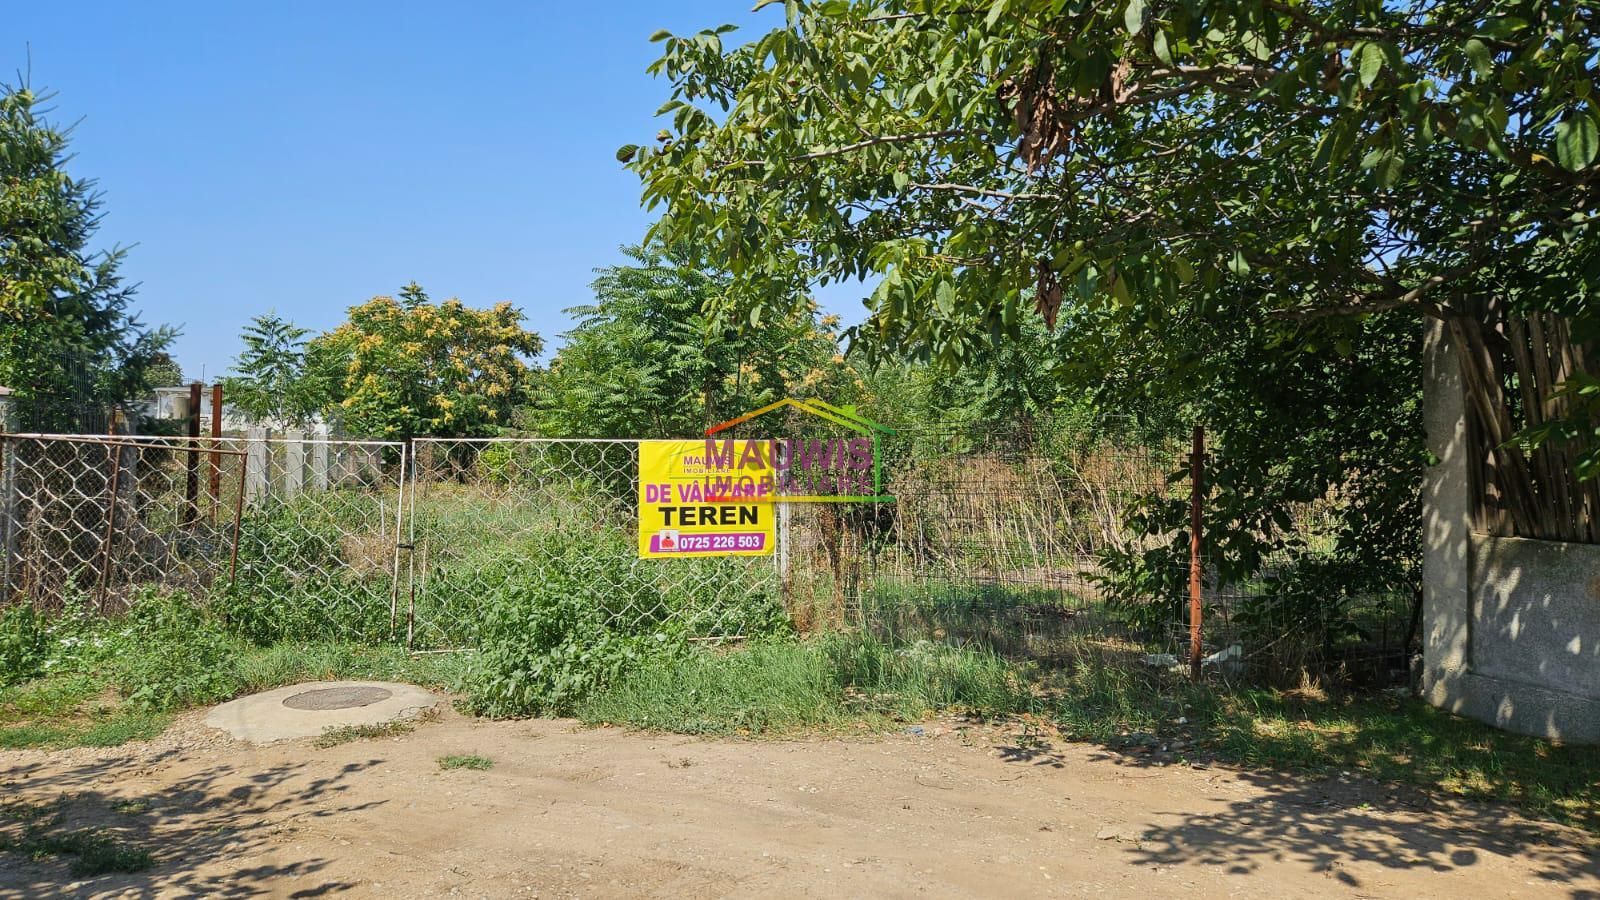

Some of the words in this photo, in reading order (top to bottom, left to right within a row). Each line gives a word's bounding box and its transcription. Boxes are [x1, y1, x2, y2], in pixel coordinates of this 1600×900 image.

[646, 483, 672, 503] DE
[658, 505, 758, 526] TEREN
[680, 537, 710, 549] 0725
[713, 536, 735, 547] 226
[738, 535, 760, 546] 503
